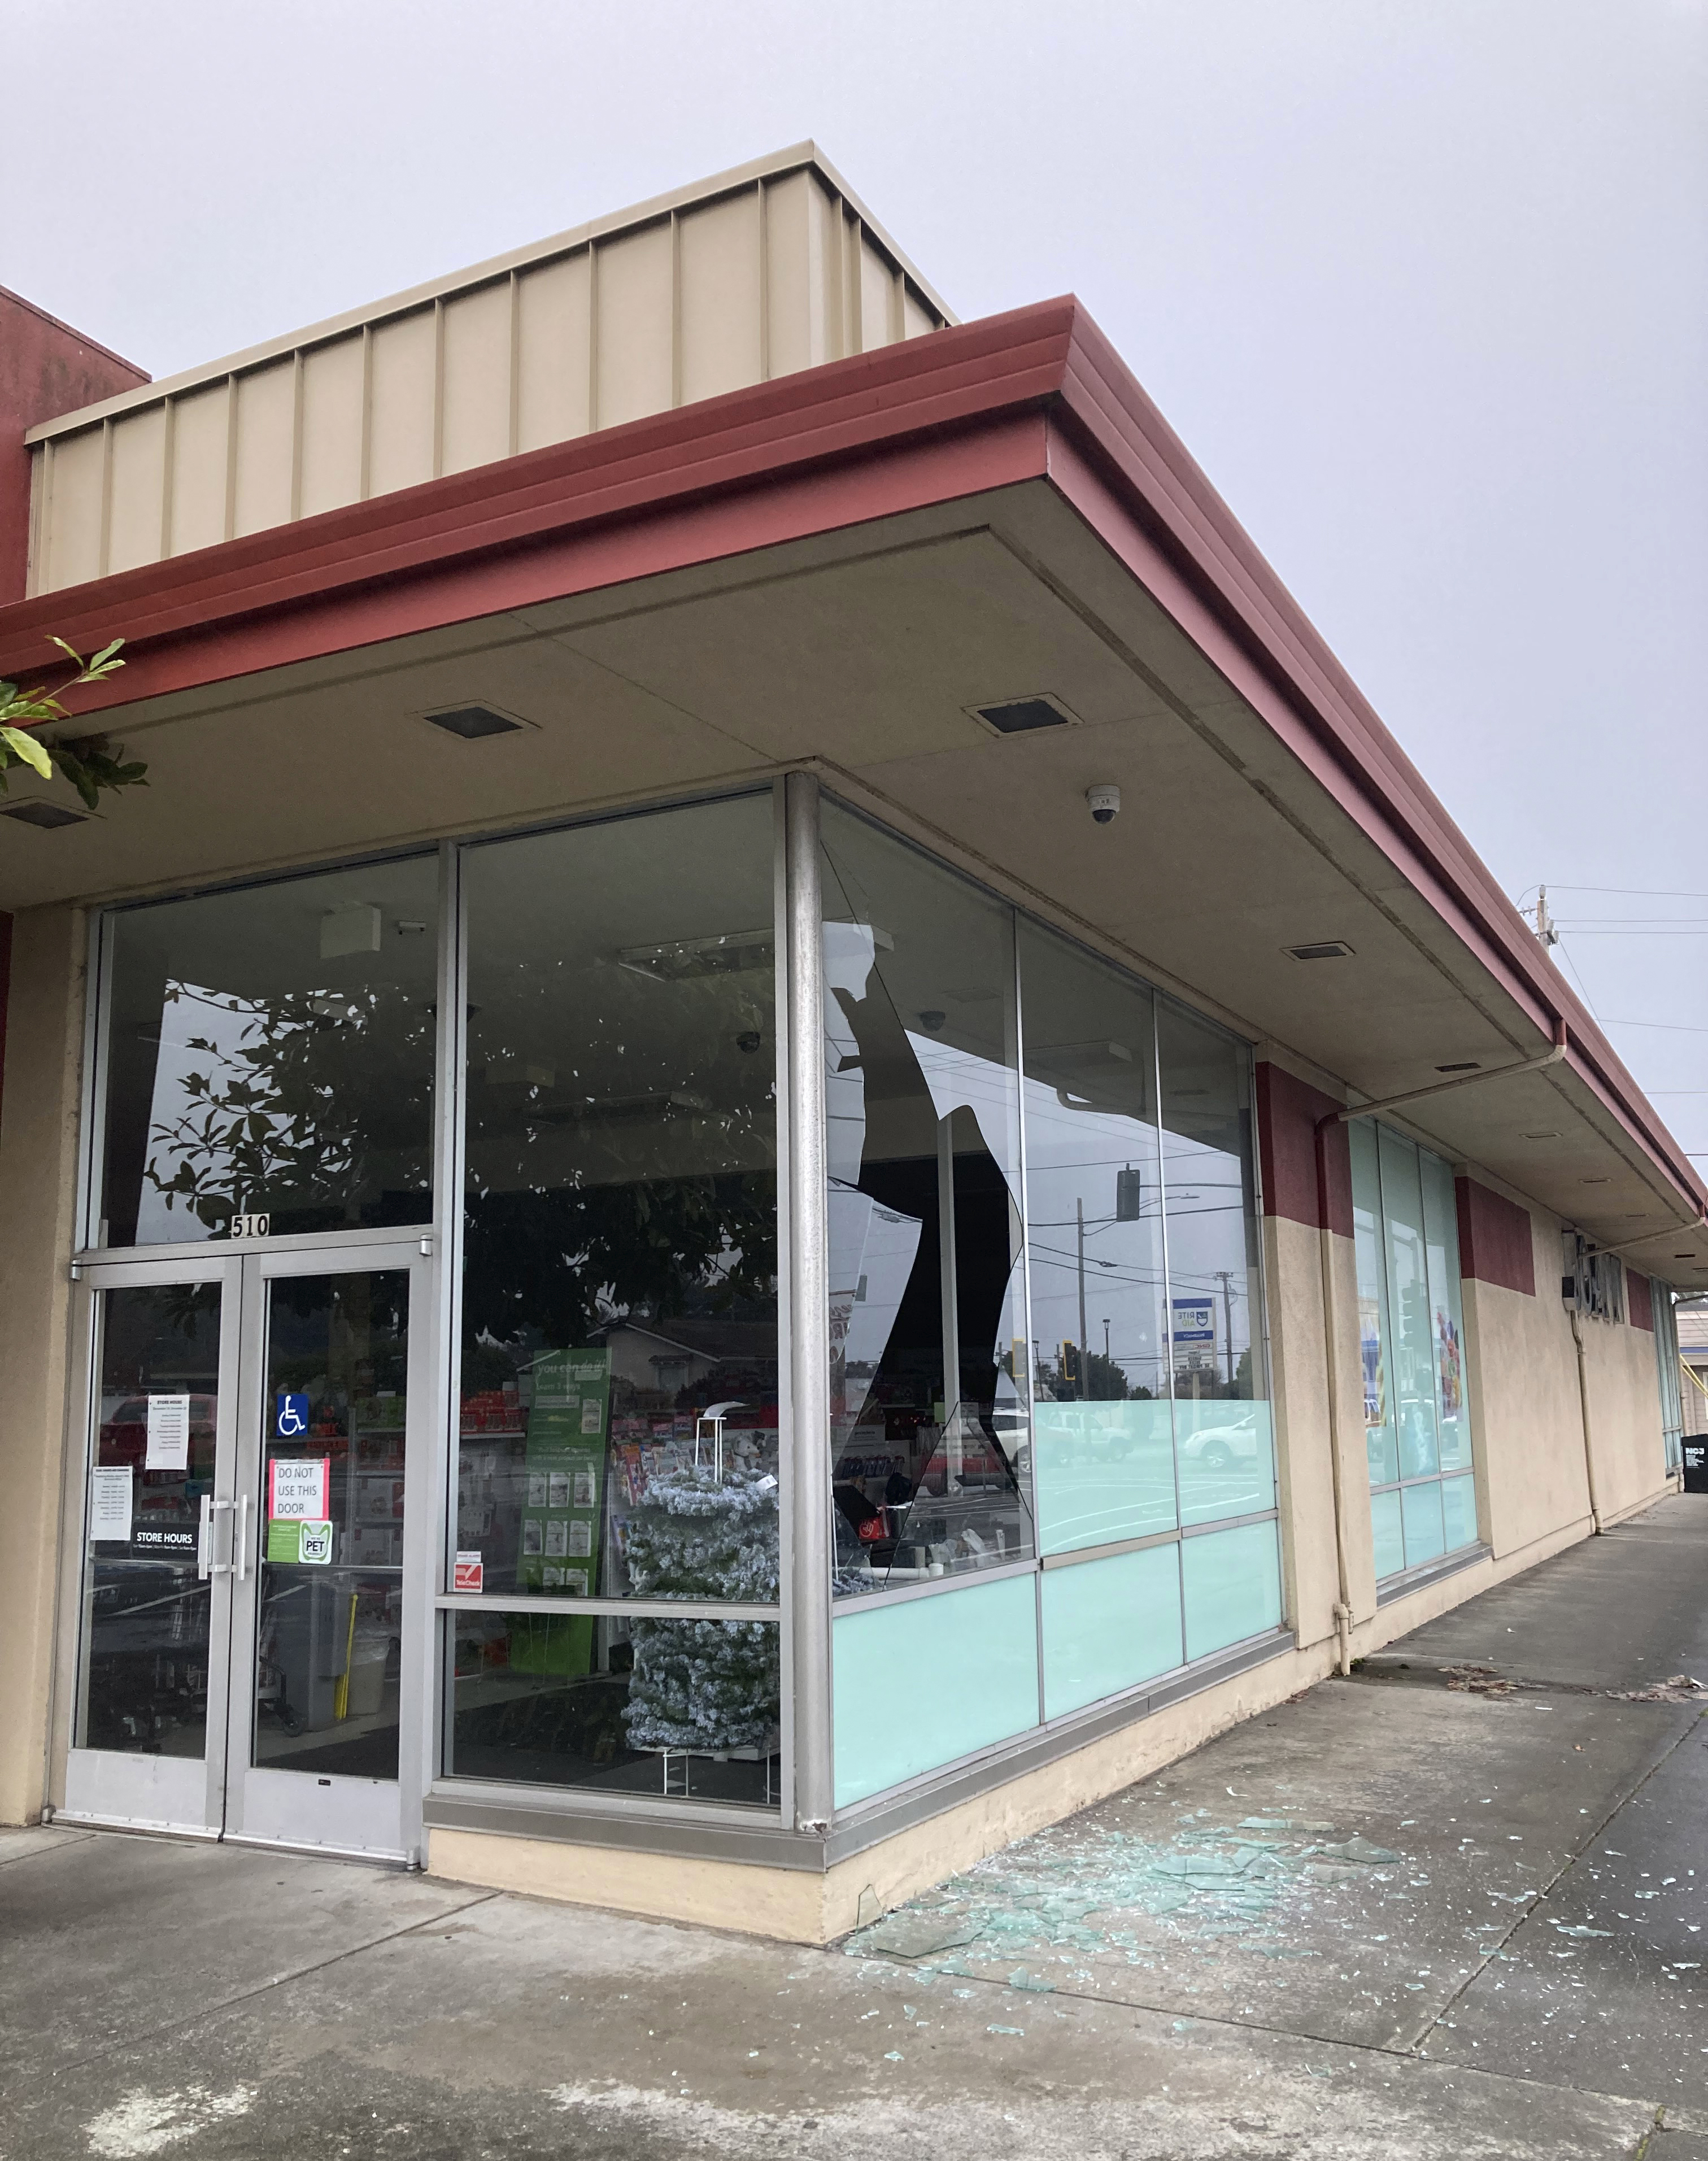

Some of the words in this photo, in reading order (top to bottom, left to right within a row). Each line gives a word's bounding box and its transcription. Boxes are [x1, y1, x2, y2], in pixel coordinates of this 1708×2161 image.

[233, 1215, 268, 1237] 510
[537, 1363, 557, 1377] you
[278, 1468, 292, 1478] DO
[294, 1467, 313, 1478] NOT
[278, 1485, 295, 1496] USE
[297, 1485, 317, 1496] THIS
[277, 1503, 304, 1514] DOOR
[137, 1532, 163, 1543] STORE
[164, 1533, 193, 1544] HOURS
[306, 1541, 325, 1552] PET
